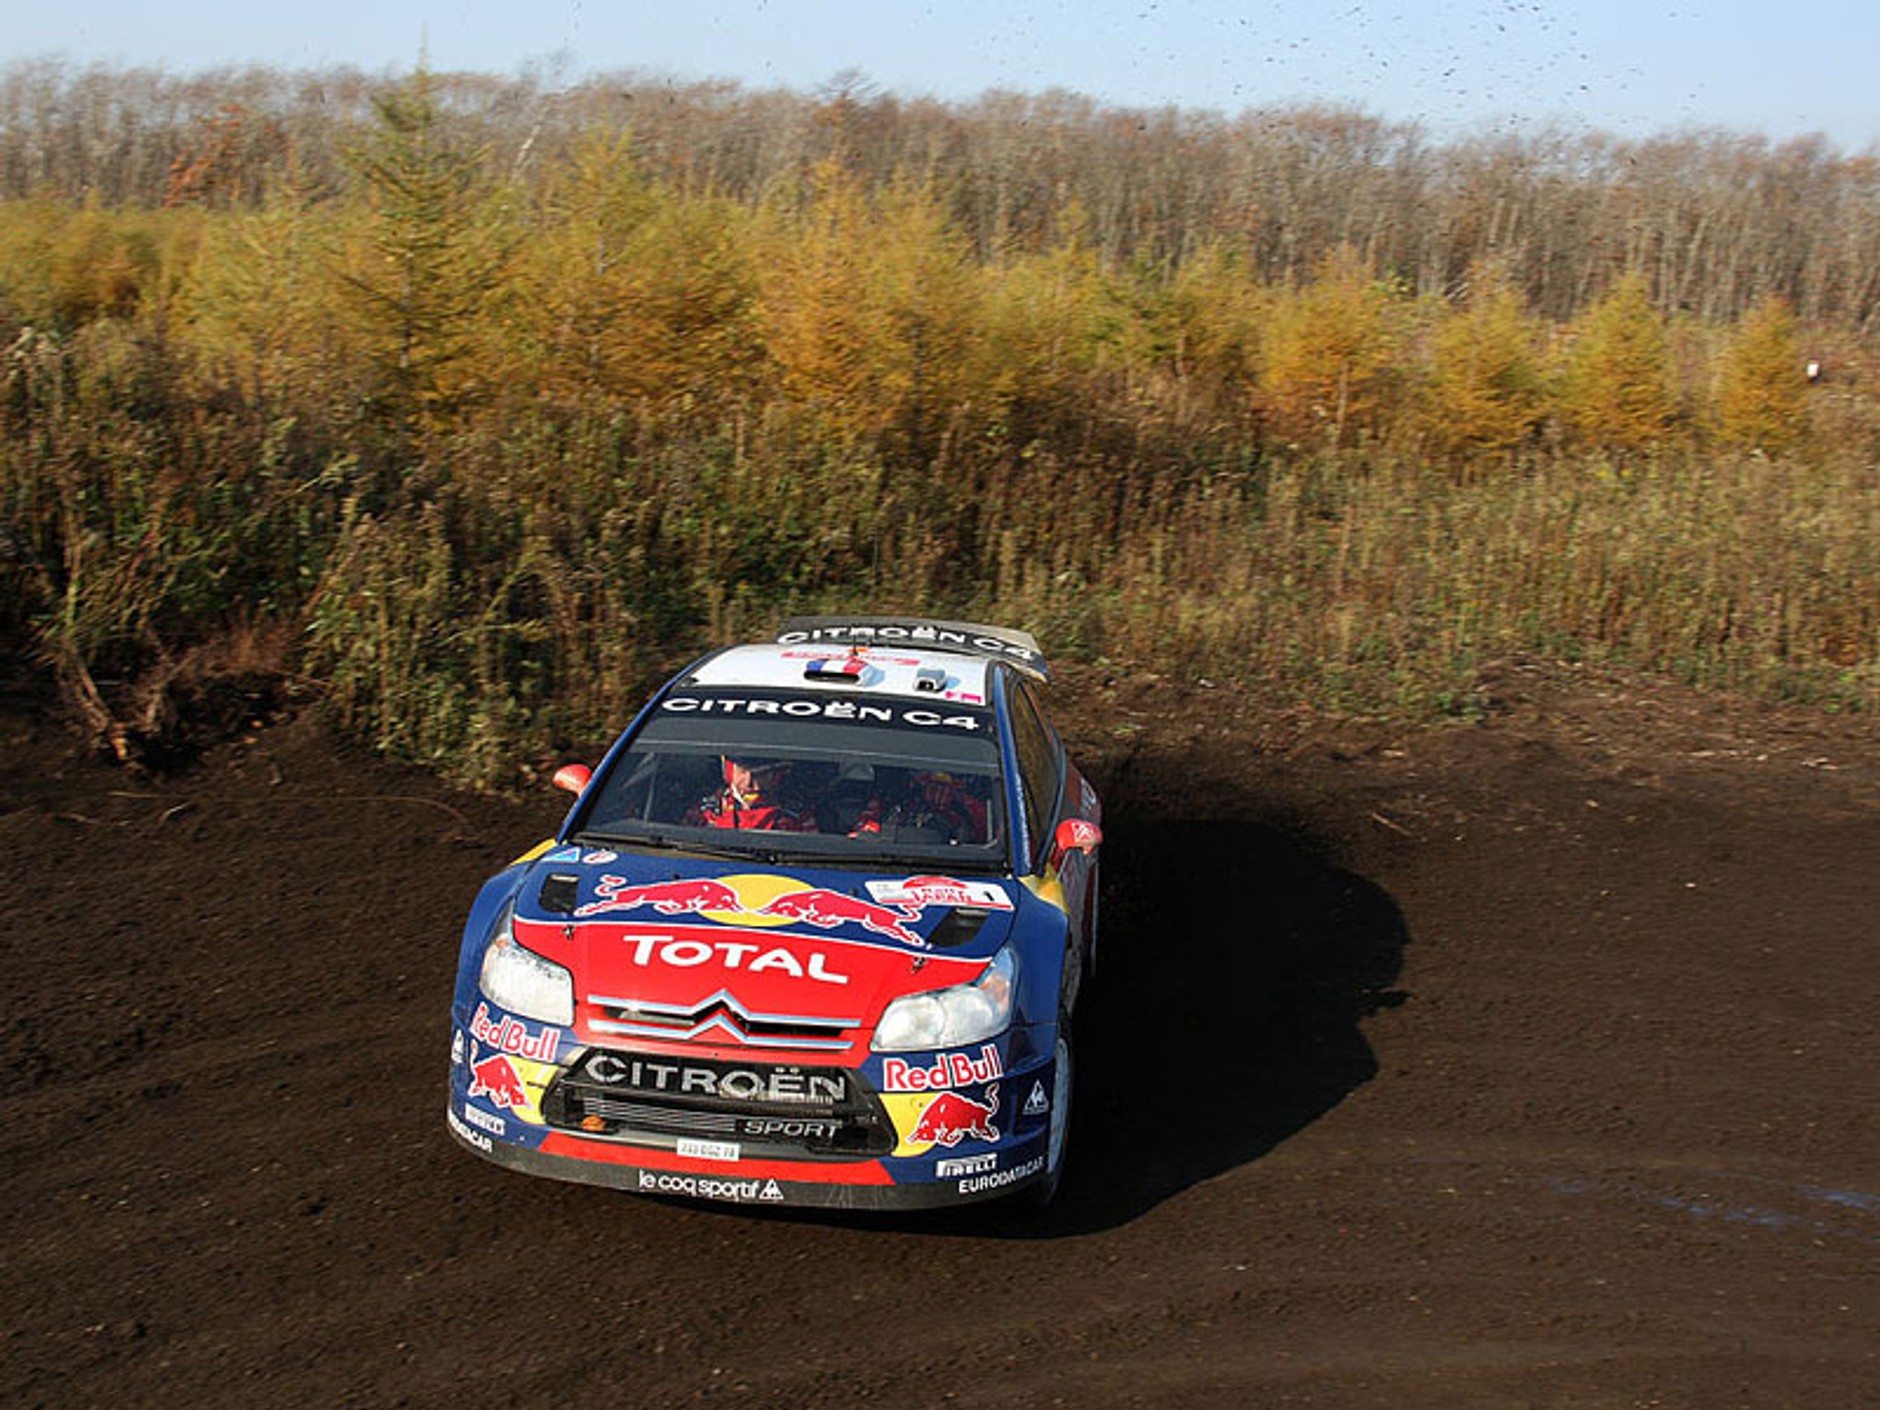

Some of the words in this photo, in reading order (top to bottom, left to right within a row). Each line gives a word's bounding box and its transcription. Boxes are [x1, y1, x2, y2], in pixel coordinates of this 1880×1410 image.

[661, 697, 893, 722] CITROËN
[902, 711, 980, 731] C4
[622, 935, 849, 985] TOTAL
[470, 1002, 510, 1048] Red
[502, 1020, 560, 1062] Bull
[585, 1055, 846, 1101] CITROËN
[884, 1053, 951, 1092] Red
[951, 1044, 1003, 1088] Bull
[744, 1118, 843, 1138] SPORT
[639, 1168, 656, 1188] le
[658, 1175, 697, 1197] coq
[698, 1179, 760, 1202] sportif
[936, 1153, 998, 1177] PIRELLI
